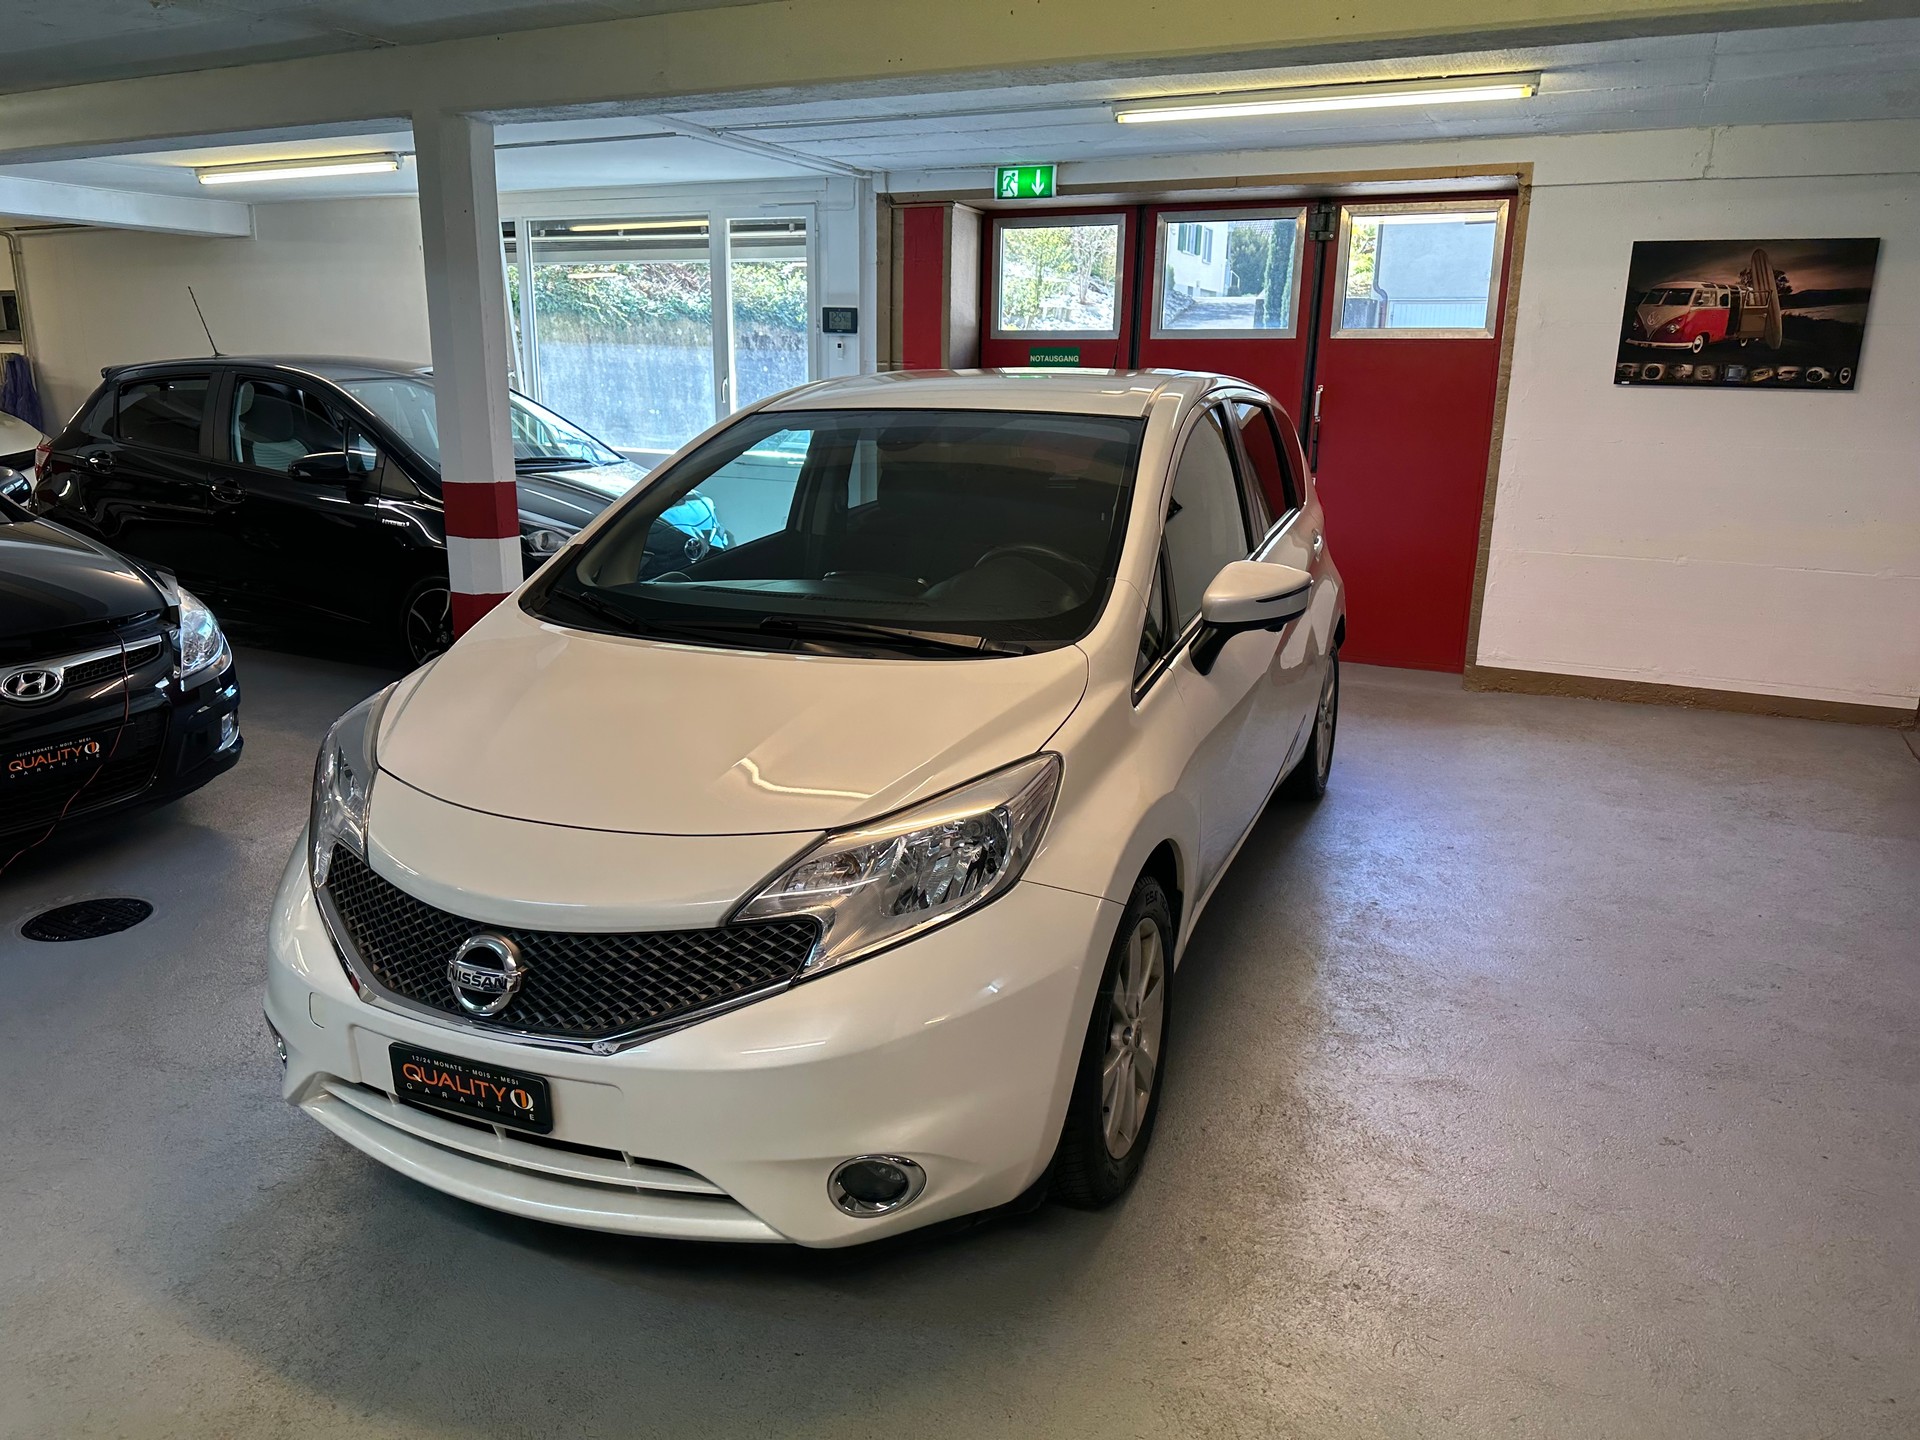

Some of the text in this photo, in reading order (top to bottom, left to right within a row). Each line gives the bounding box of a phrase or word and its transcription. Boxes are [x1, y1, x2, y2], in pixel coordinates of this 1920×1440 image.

[8, 745, 83, 772] QUALITY
[33, 745, 53, 754] MONATE
[10, 753, 100, 779] GARANTIE
[448, 964, 507, 990] NISSAN
[403, 1063, 506, 1102] QUALITY
[412, 1055, 431, 1064] 12/24
[433, 1060, 463, 1072] MONATE
[472, 1069, 491, 1079] MOIS
[501, 1076, 519, 1086] MESI
[406, 1082, 535, 1121] GARANTIE
